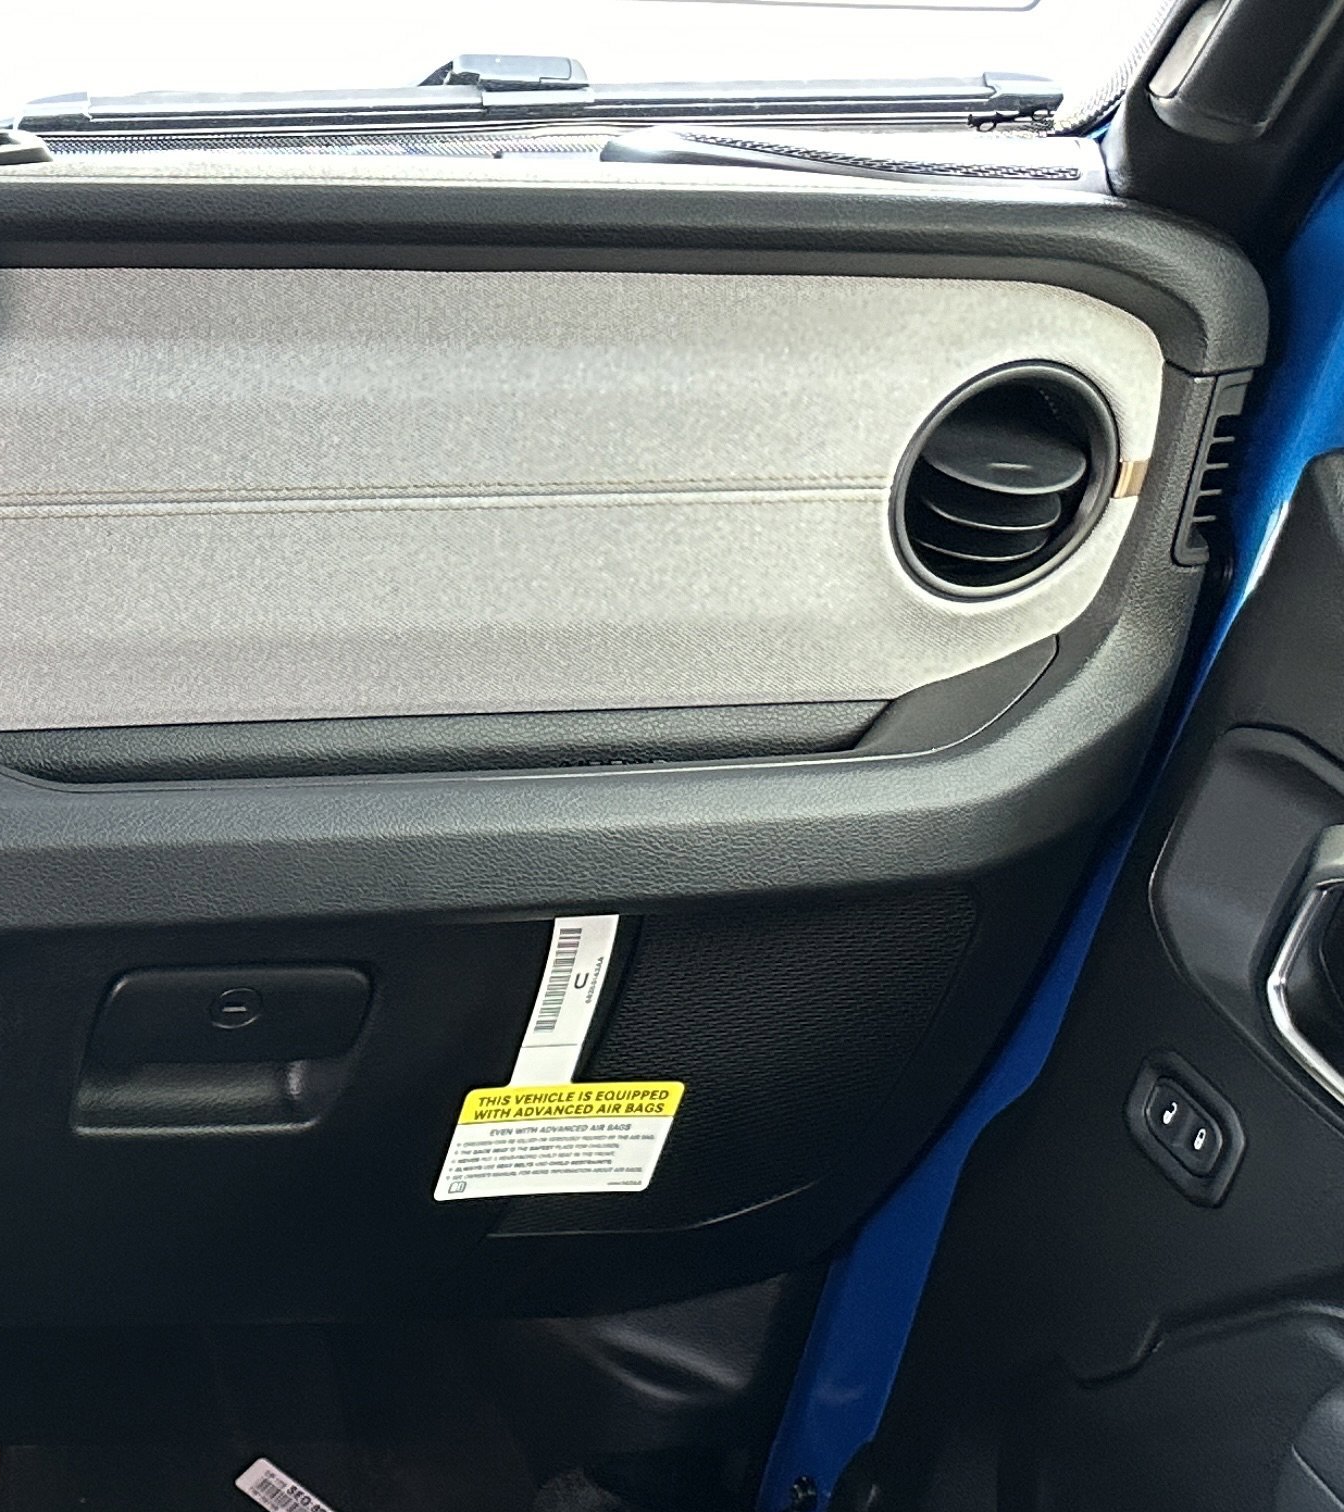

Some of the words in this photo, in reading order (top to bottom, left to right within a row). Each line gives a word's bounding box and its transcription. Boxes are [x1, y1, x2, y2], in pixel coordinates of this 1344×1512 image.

[478, 1095, 510, 1107] THIS
[515, 1092, 574, 1105] VEHICLE
[577, 1091, 591, 1102] IS
[595, 1089, 669, 1102] EQUIPPED
[474, 1108, 510, 1120] WITH
[514, 1104, 592, 1117] ADVANCED
[597, 1104, 621, 1114] AIR
[624, 1103, 664, 1114] BAGS
[489, 1128, 513, 1137] EVEN
